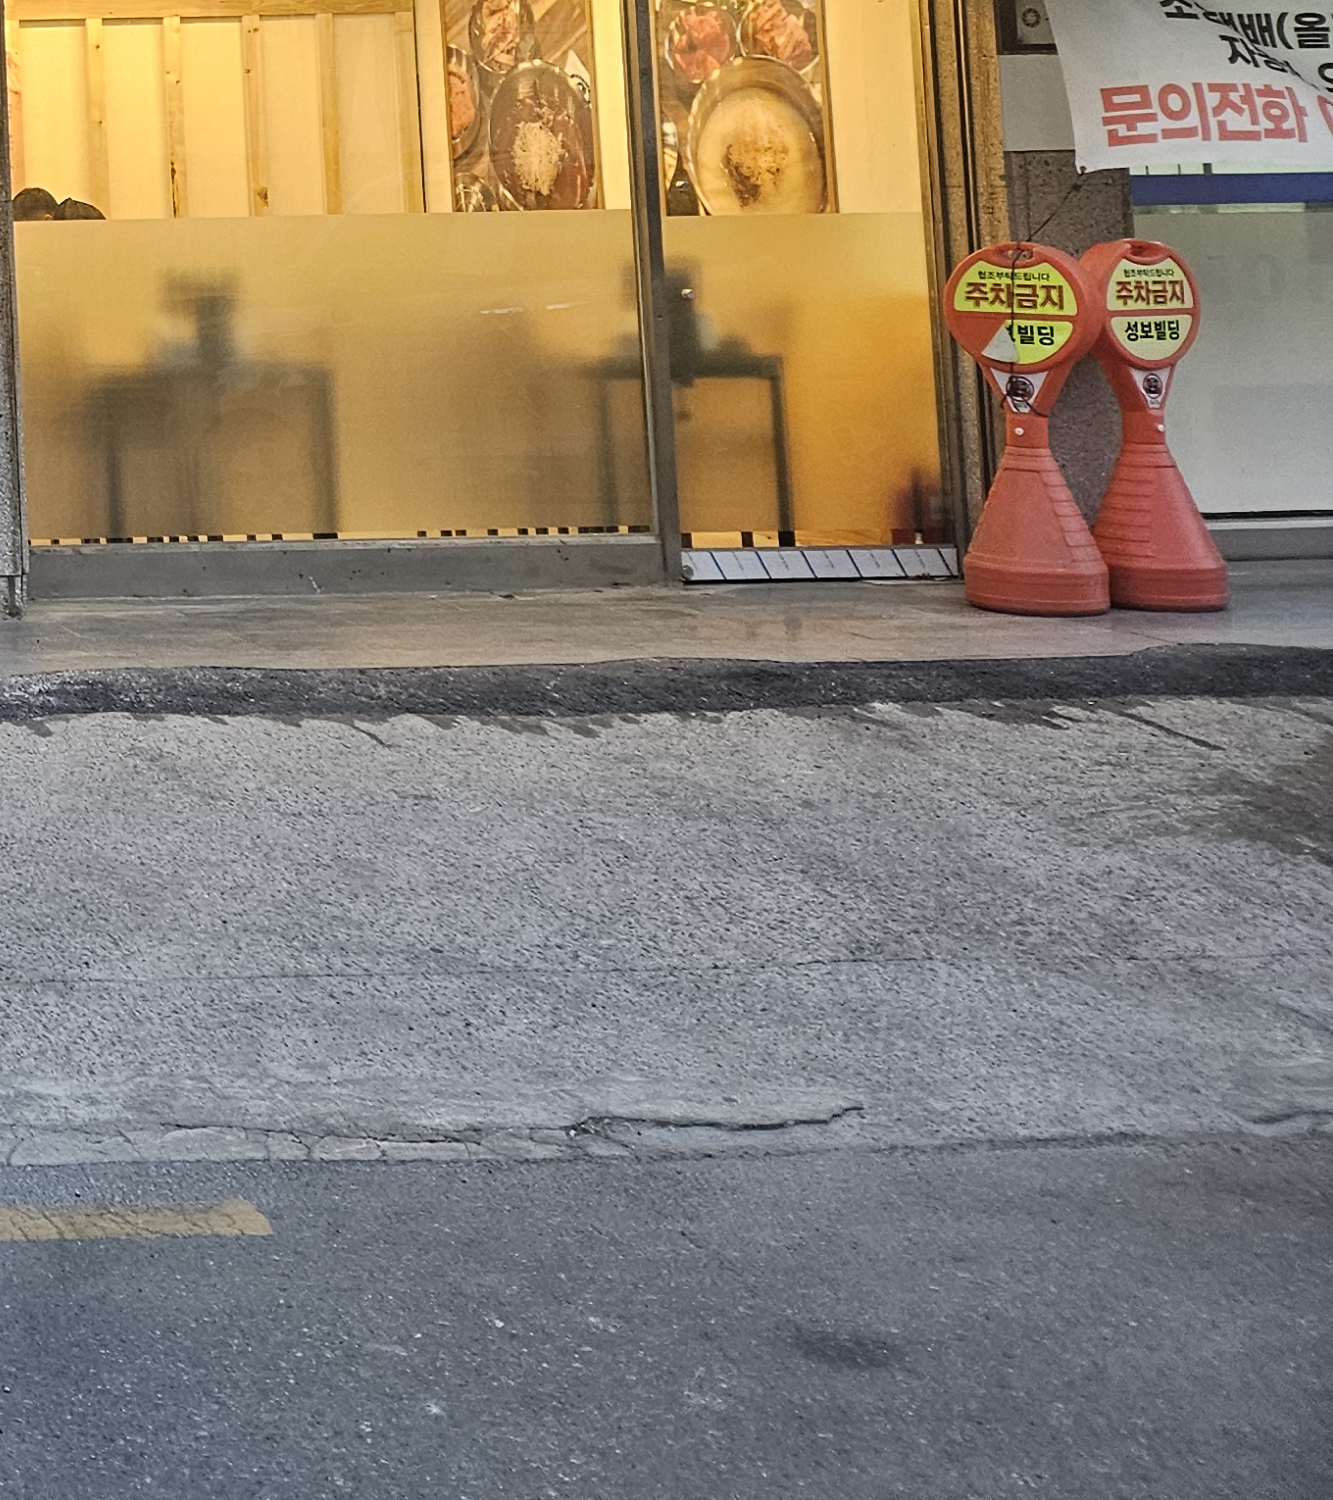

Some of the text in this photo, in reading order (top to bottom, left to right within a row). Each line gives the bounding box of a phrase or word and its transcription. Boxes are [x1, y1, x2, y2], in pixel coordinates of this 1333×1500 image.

[1100, 82, 1308, 147] 문의전화
[965, 282, 1065, 311] 주차금지
[1116, 279, 1185, 306] 주차금지
[1125, 320, 1180, 342] 성보빌딩
